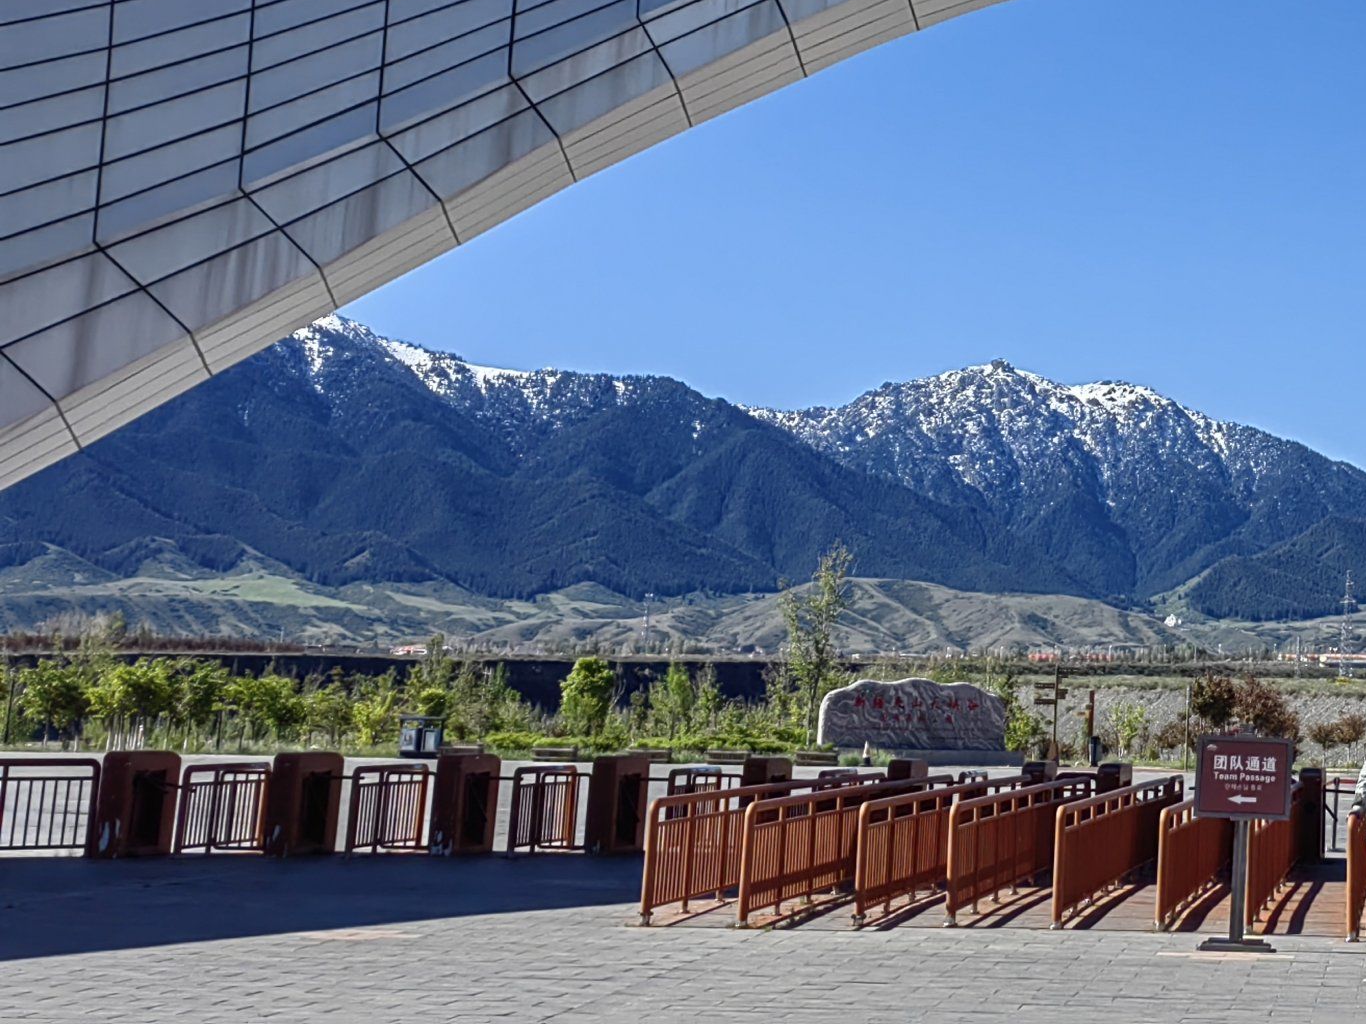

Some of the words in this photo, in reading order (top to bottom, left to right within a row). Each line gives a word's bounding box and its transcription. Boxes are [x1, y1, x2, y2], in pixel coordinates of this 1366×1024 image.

[1213, 754, 1277, 772] 团队通道
[1214, 772, 1238, 781] Team
[1239, 772, 1276, 784] Passage
